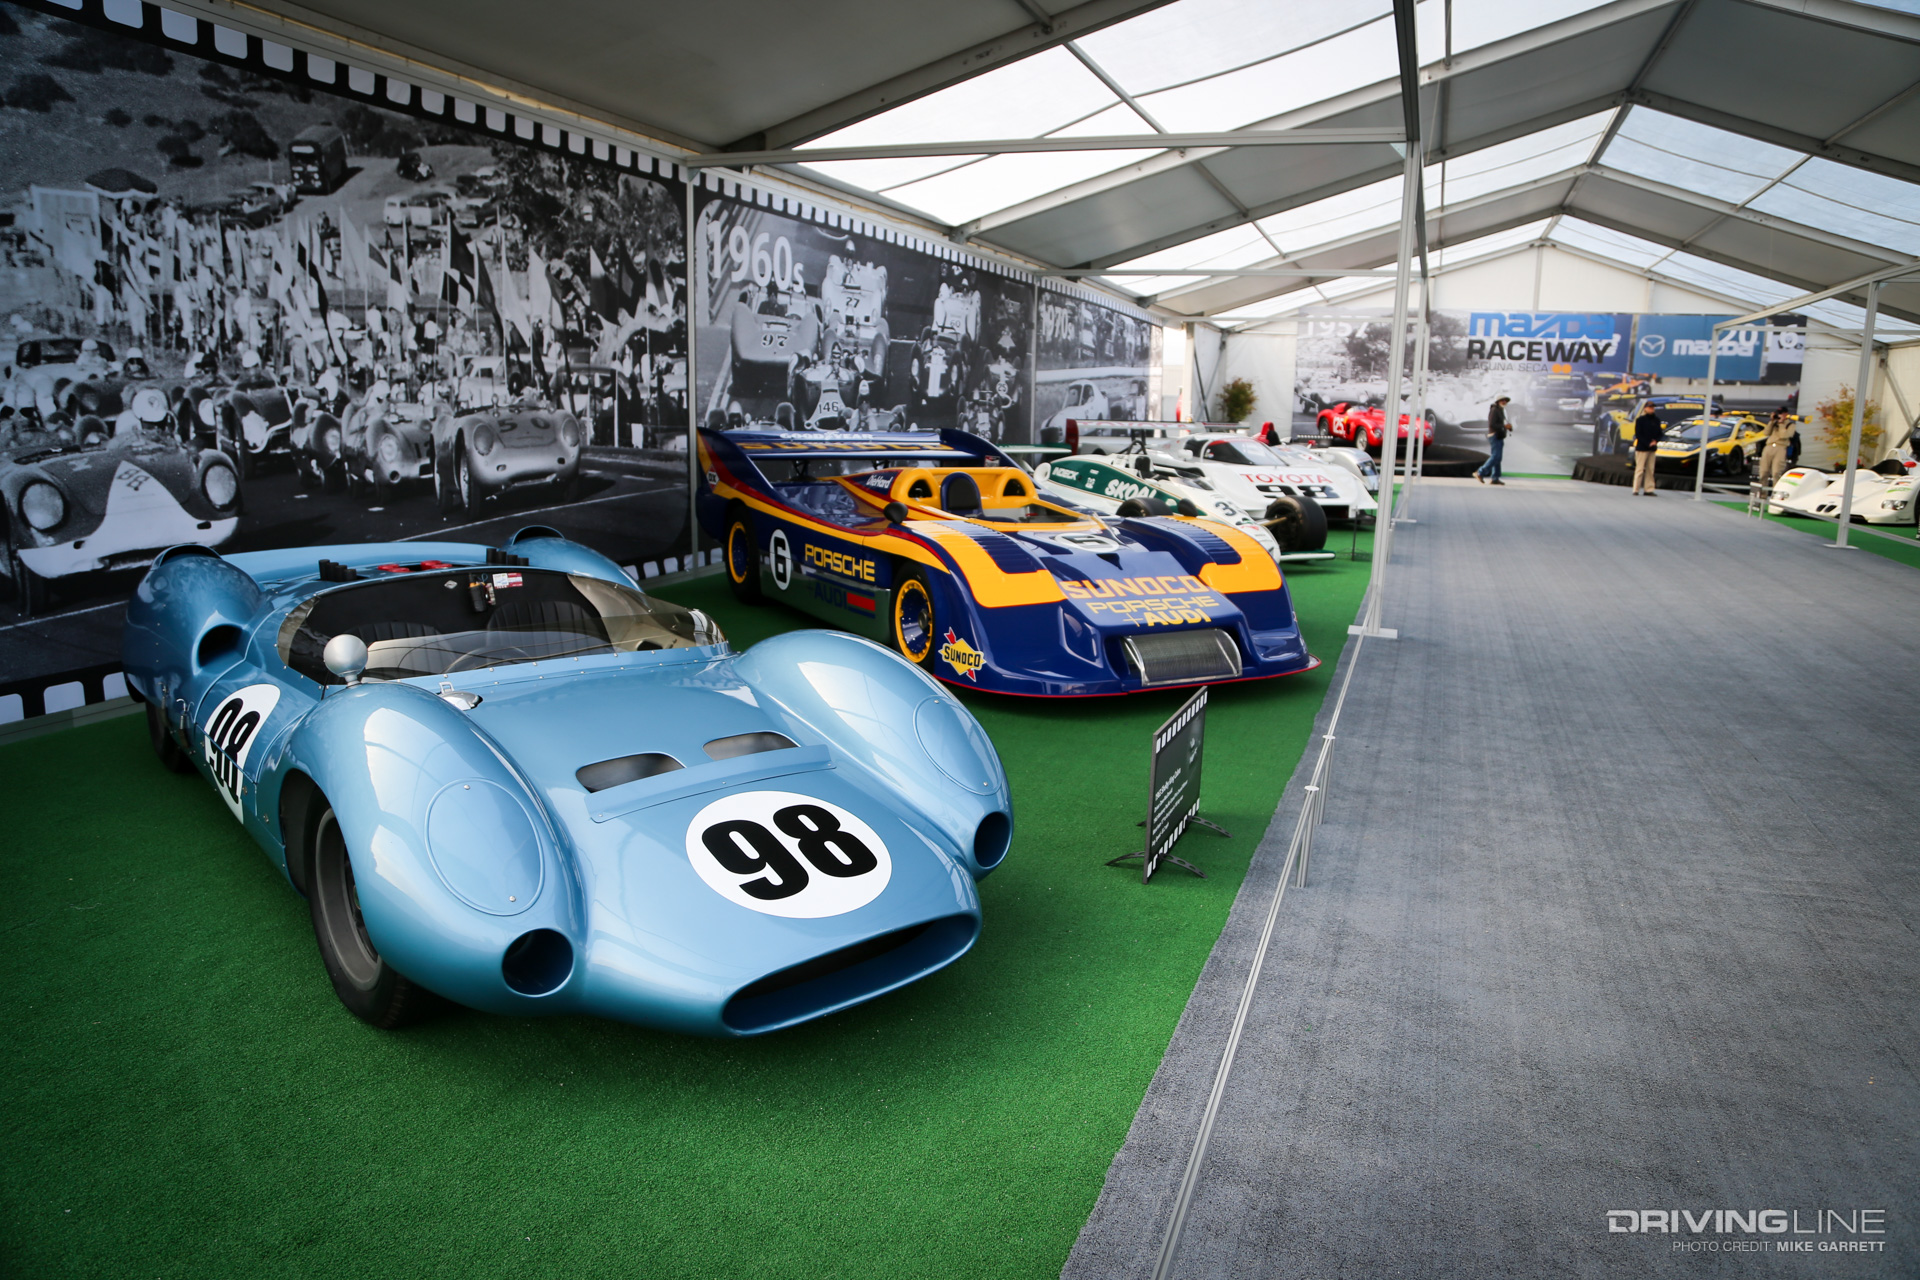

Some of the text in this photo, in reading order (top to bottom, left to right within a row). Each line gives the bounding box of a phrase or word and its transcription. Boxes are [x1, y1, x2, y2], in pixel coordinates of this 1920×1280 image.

[707, 219, 805, 293] 1960s
[846, 297, 860, 308] 27
[1306, 314, 1370, 338] 1957
[1718, 323, 1800, 348] 2016
[761, 334, 788, 347] 97
[1466, 339, 1612, 364] RACEWAY
[1466, 361, 1549, 374] LAGUNA SECA
[818, 401, 840, 414] 146
[499, 416, 550, 433] 50
[1240, 474, 1333, 484] TOYOTA
[774, 536, 787, 584] 6
[804, 543, 875, 582] PORSCHE
[1058, 575, 1210, 600] SUNOCO
[1086, 595, 1220, 615] PORSCHE
[944, 645, 981, 667] SUNOCO
[208, 698, 261, 805] 98
[701, 803, 878, 901] 98
